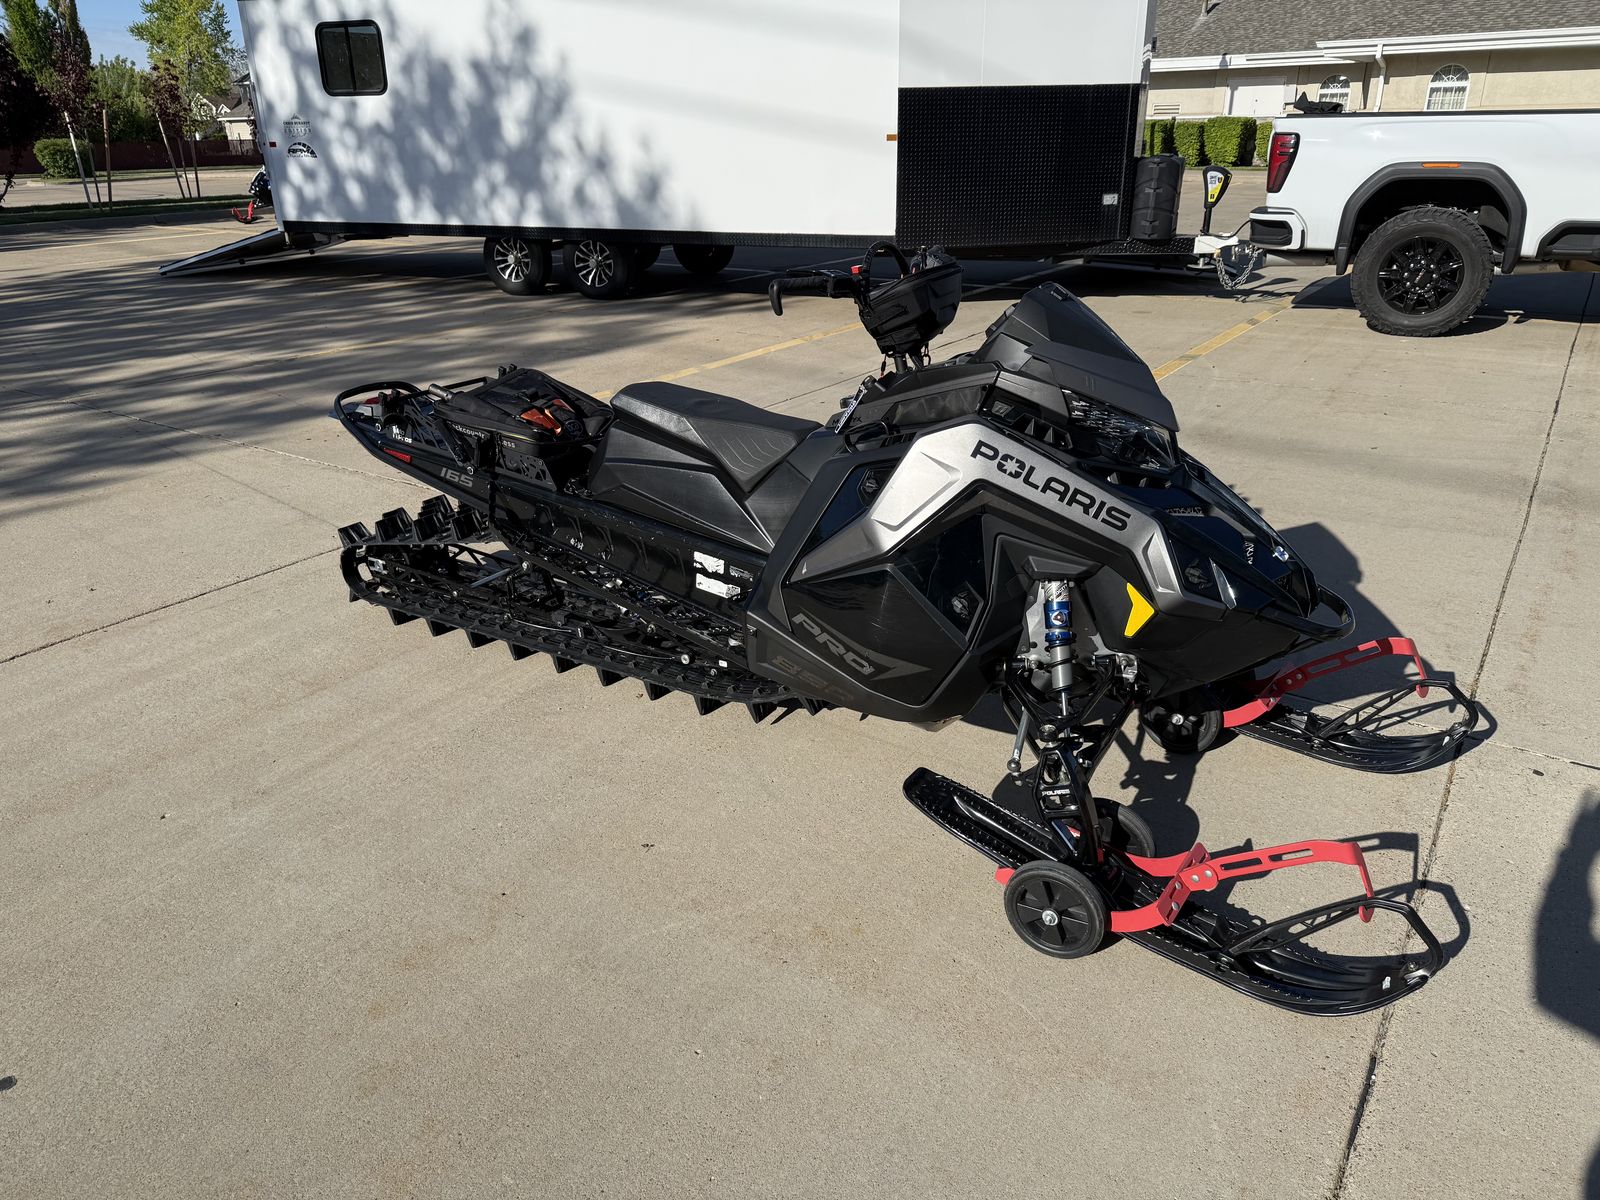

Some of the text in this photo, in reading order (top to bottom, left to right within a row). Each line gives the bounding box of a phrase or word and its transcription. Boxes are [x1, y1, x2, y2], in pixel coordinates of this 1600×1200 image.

[440, 467, 473, 488] 165
[970, 439, 1132, 532] POLARIS
[791, 612, 876, 676] PRO
